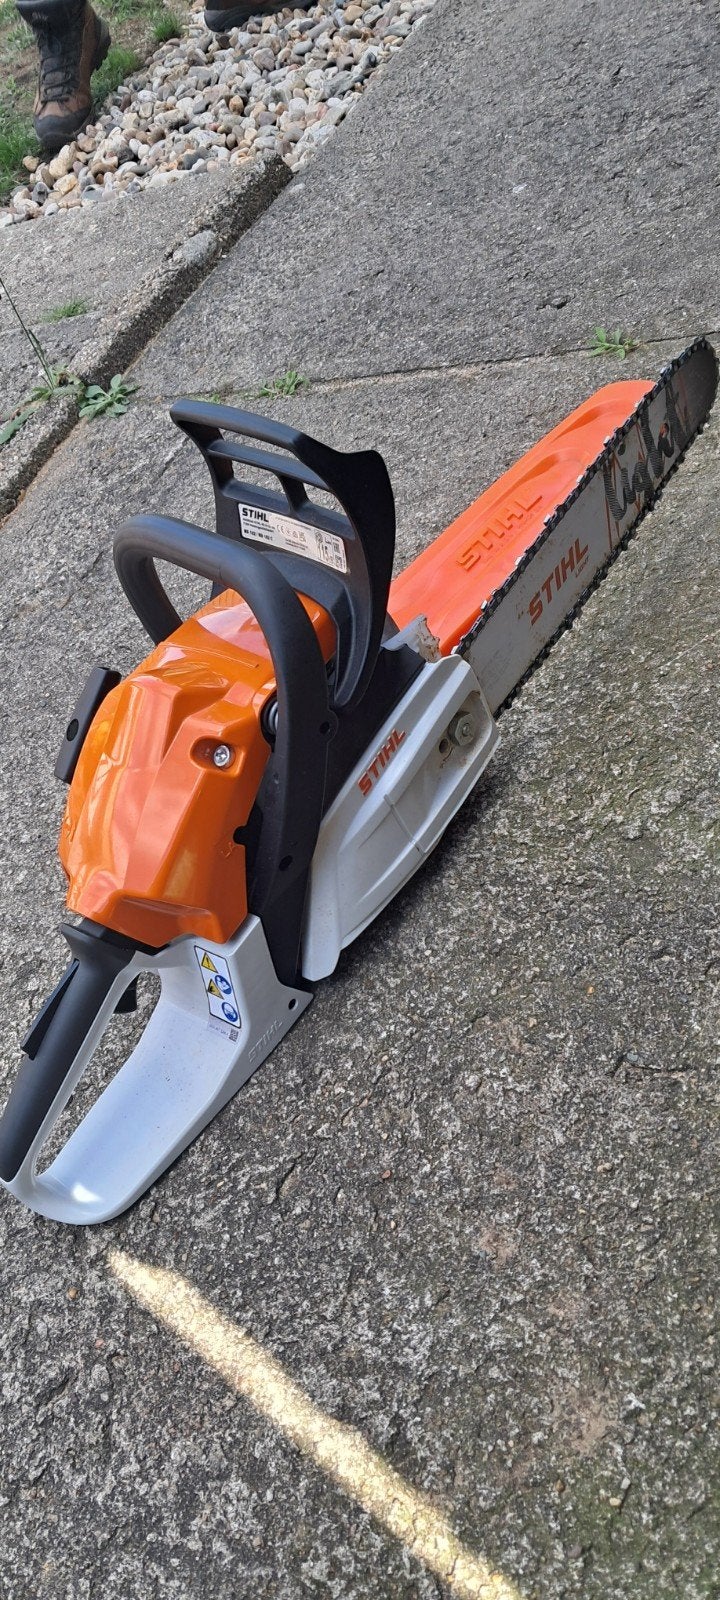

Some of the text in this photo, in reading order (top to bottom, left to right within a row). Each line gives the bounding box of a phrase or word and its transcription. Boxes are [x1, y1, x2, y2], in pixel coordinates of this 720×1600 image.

[242, 508, 269, 522] STIHL
[455, 496, 543, 572] STIHL
[529, 538, 589, 626] STIHL
[357, 728, 406, 797] STIHL
[248, 1019, 283, 1063] STIHL
